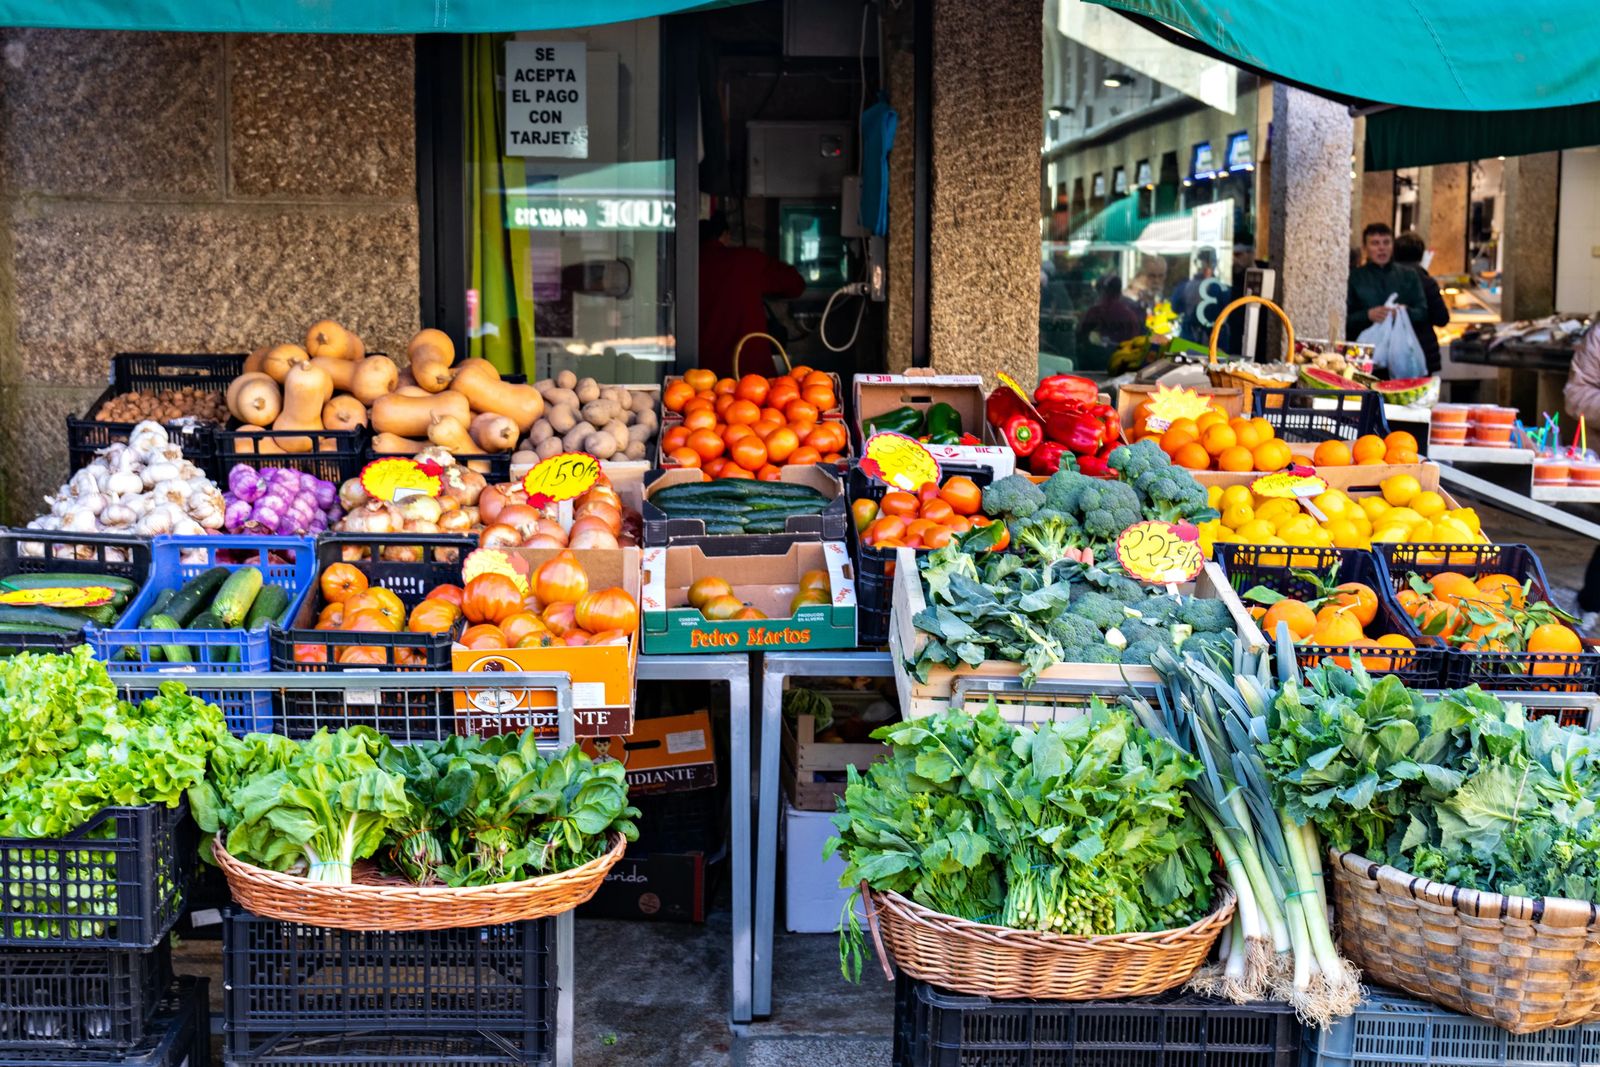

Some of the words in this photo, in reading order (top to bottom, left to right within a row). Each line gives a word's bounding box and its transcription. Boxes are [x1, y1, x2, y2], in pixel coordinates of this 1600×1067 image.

[535, 47, 555, 61] SE
[514, 68, 576, 82] ACEPTA
[512, 89, 531, 103] EL
[535, 89, 579, 103] PAGO
[529, 110, 562, 124] CON
[690, 628, 739, 648] Pedro
[746, 626, 811, 646] Martos
